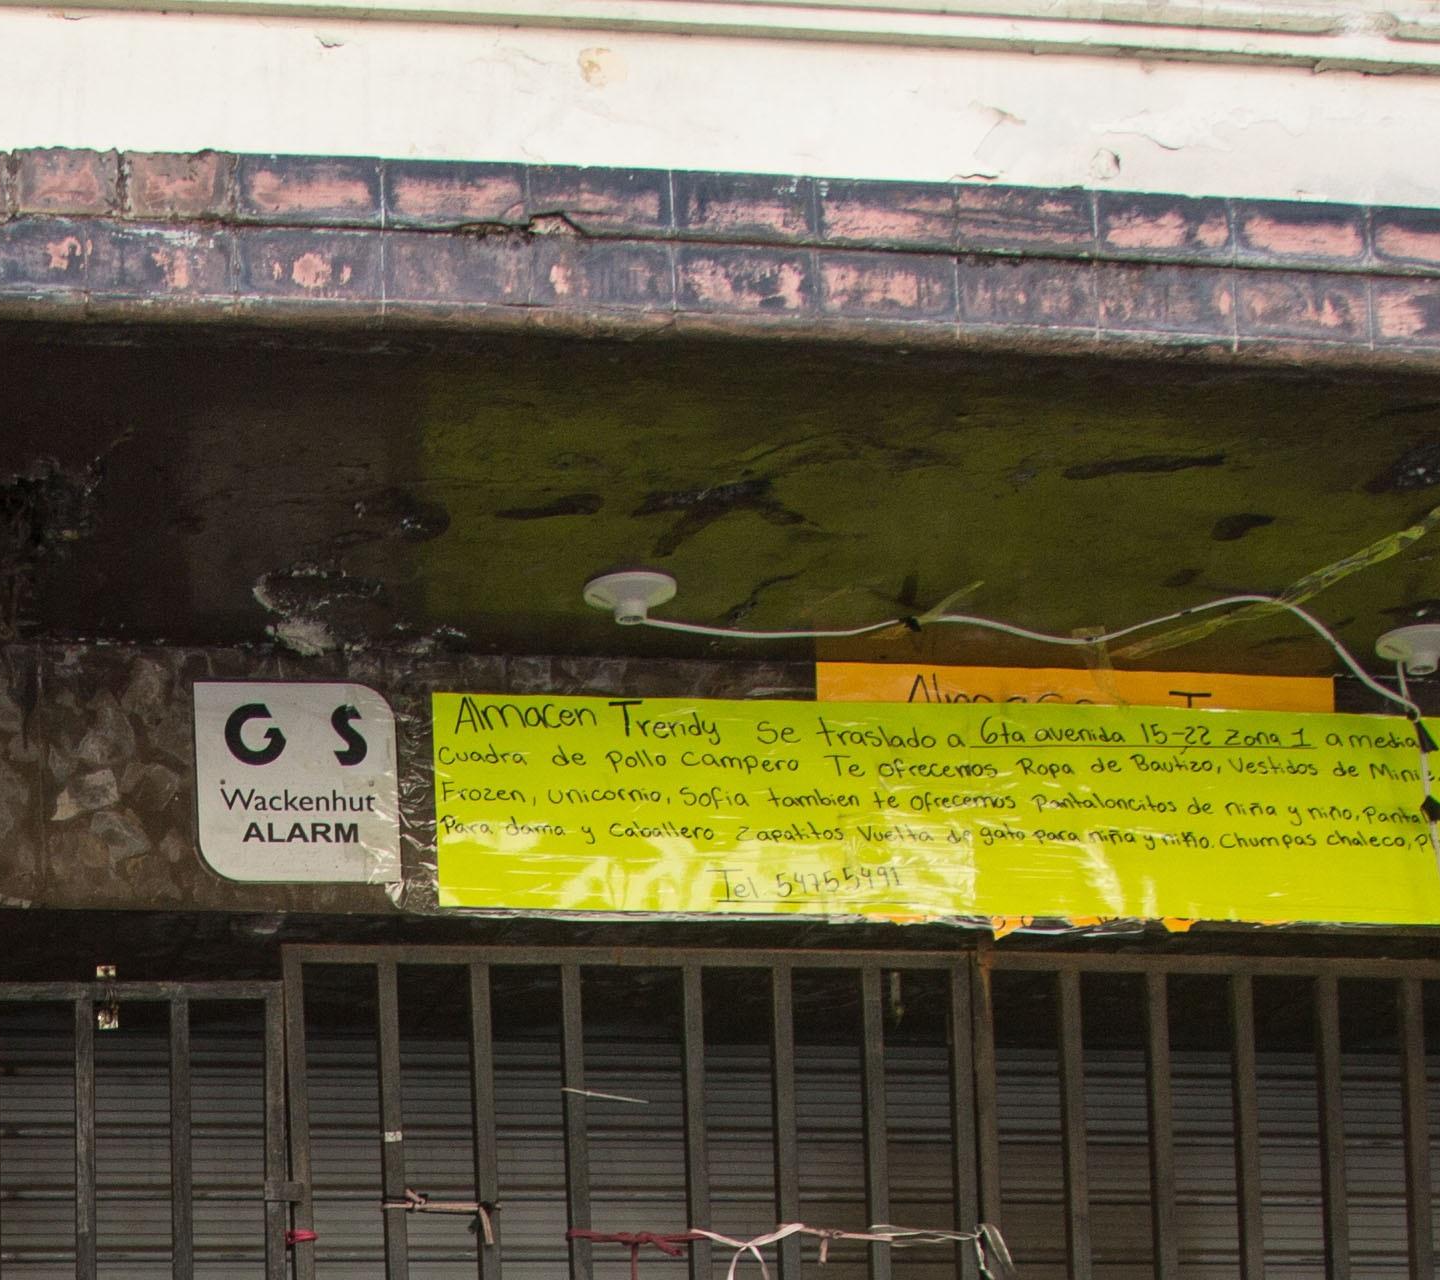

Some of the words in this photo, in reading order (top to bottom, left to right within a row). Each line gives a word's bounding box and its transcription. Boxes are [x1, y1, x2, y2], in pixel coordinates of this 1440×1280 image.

[454, 696, 598, 735] Almacen
[608, 699, 721, 746] Trendy
[815, 716, 937, 748] traslado
[947, 730, 967, 748] a
[1034, 726, 1127, 744] avenida
[1291, 727, 1312, 747] 1
[551, 744, 587, 767] de
[823, 754, 866, 779] Te
[1090, 756, 1122, 773] de
[1332, 759, 1360, 778] de
[219, 788, 376, 812] Wackenhut
[768, 787, 860, 808] tambien
[873, 790, 900, 809] te
[1186, 797, 1214, 815] de
[1288, 805, 1304, 826] y
[242, 821, 360, 844] ALARM
[505, 815, 566, 837] dama
[580, 827, 597, 846] y
